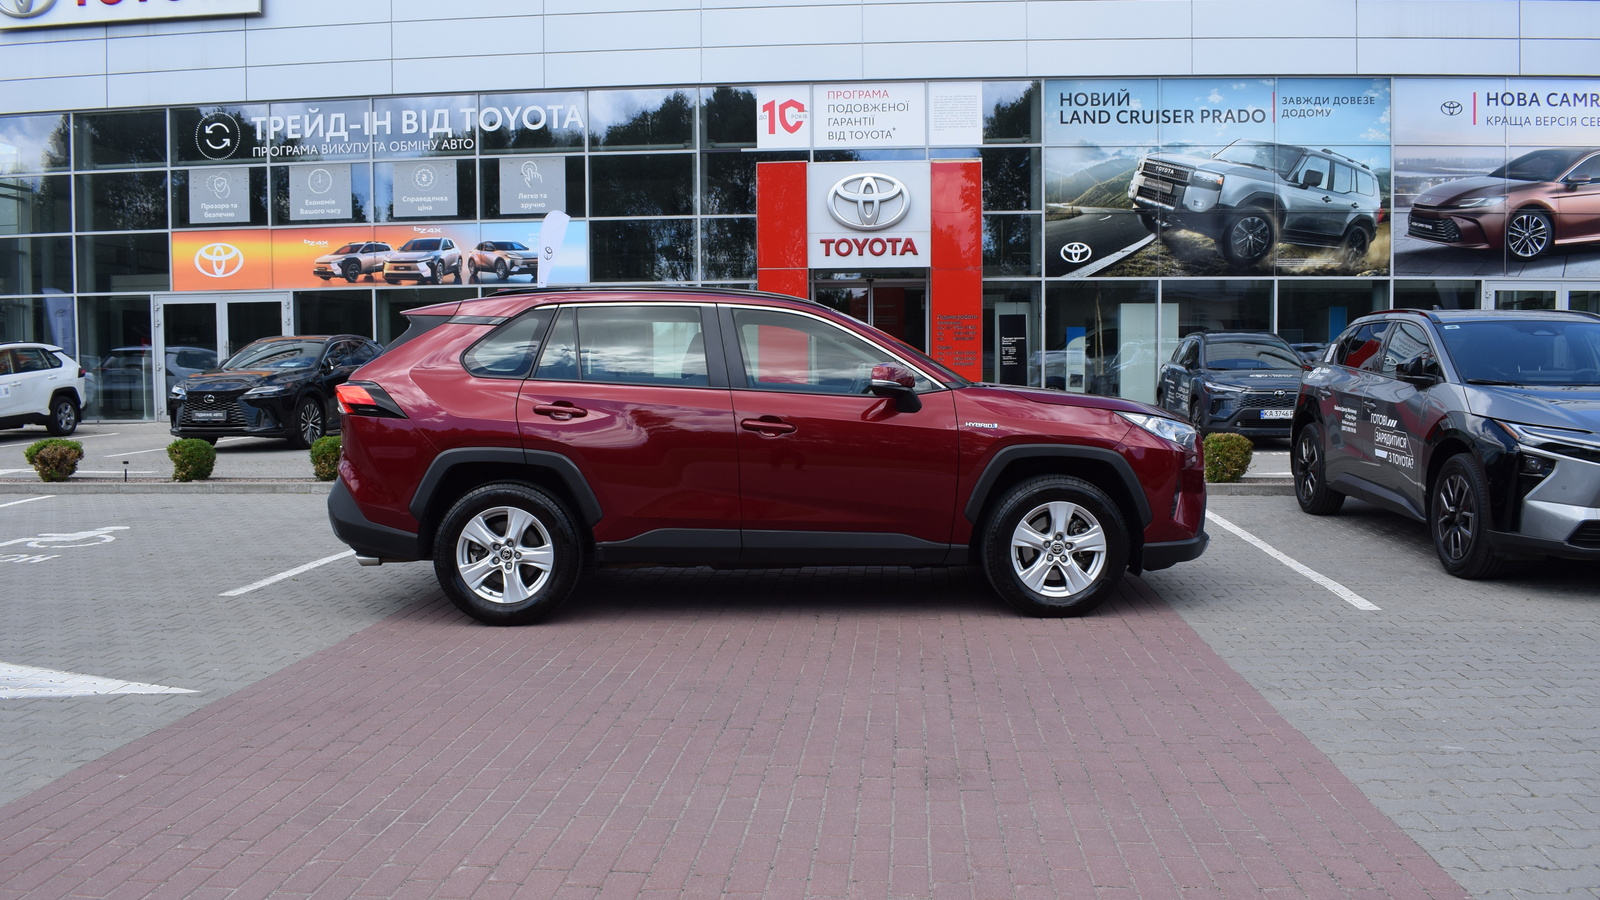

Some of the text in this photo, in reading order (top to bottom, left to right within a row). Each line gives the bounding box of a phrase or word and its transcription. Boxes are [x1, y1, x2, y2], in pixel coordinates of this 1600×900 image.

[827, 90, 890, 100] ПРОГРАМА
[1059, 88, 1131, 107] НОВИЙ
[1281, 95, 1375, 107] ЗАВЖДИ ДОВЕЗЕ
[1486, 91, 1600, 107] НОВА CAMR
[827, 101, 910, 115] ПОДОВЖЕНОЇ
[1281, 108, 1333, 119] ДОДОМУ
[251, 103, 585, 142] ТРЕЙД-ІН ВІД TOYOTA
[827, 114, 876, 127] ГАРАНТІЇ
[1059, 108, 1266, 125] LAND CRUISER PRADO
[1486, 115, 1532, 128] КРАЩА
[1535, 116, 1577, 127] ВЕРСІЯ
[827, 130, 847, 142] ВІД
[252, 138, 475, 158] ПРОГРАМА ВИКУПУ ТА ОБМІНУ АВТО
[304, 198, 336, 206] Економія
[401, 195, 449, 203] Справедлива
[518, 192, 539, 200] Легко
[200, 202, 231, 210] Прозоро
[417, 203, 433, 212] ціна
[520, 202, 546, 210] зручно
[819, 237, 919, 257] TOYOTA
[965, 421, 993, 429] HYBRID
[1375, 431, 1407, 449] ЗАРЯДИТИСЯ
